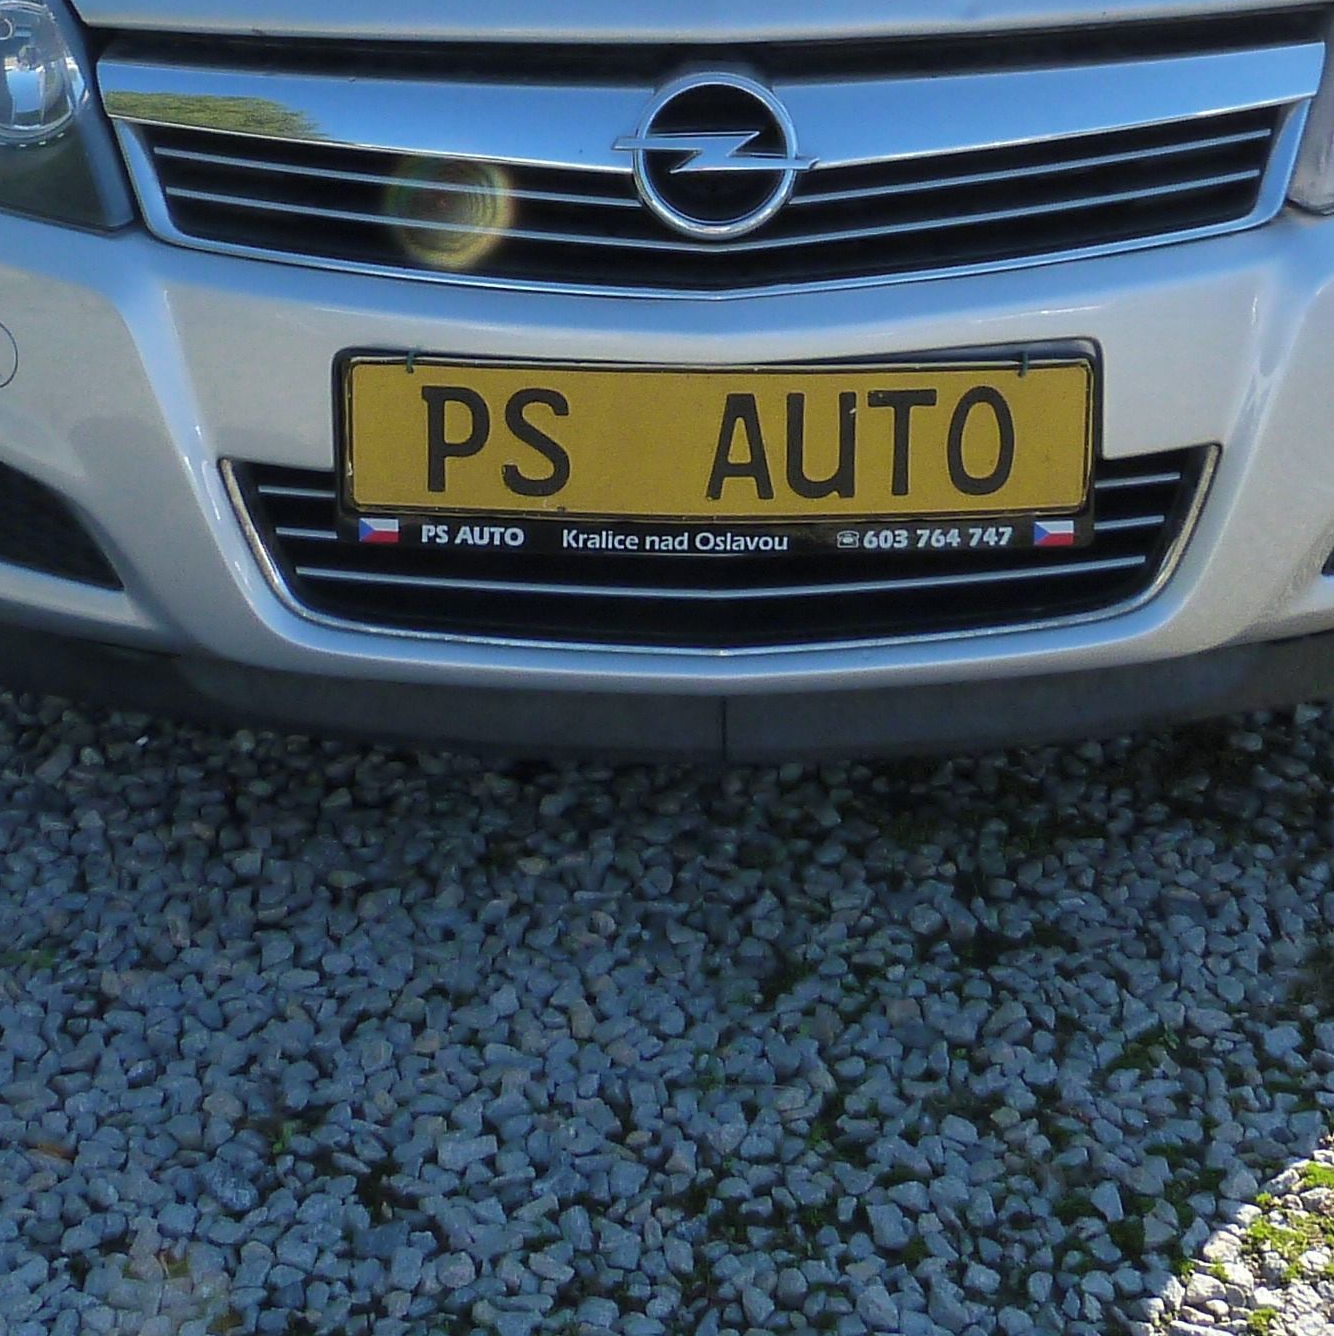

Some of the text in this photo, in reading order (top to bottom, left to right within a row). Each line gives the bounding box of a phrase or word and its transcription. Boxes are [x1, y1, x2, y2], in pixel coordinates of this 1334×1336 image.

[421, 384, 1015, 500] PS AUTO
[421, 524, 1013, 551] PS AUTO Kralice nad Oslavou 603 764 747
